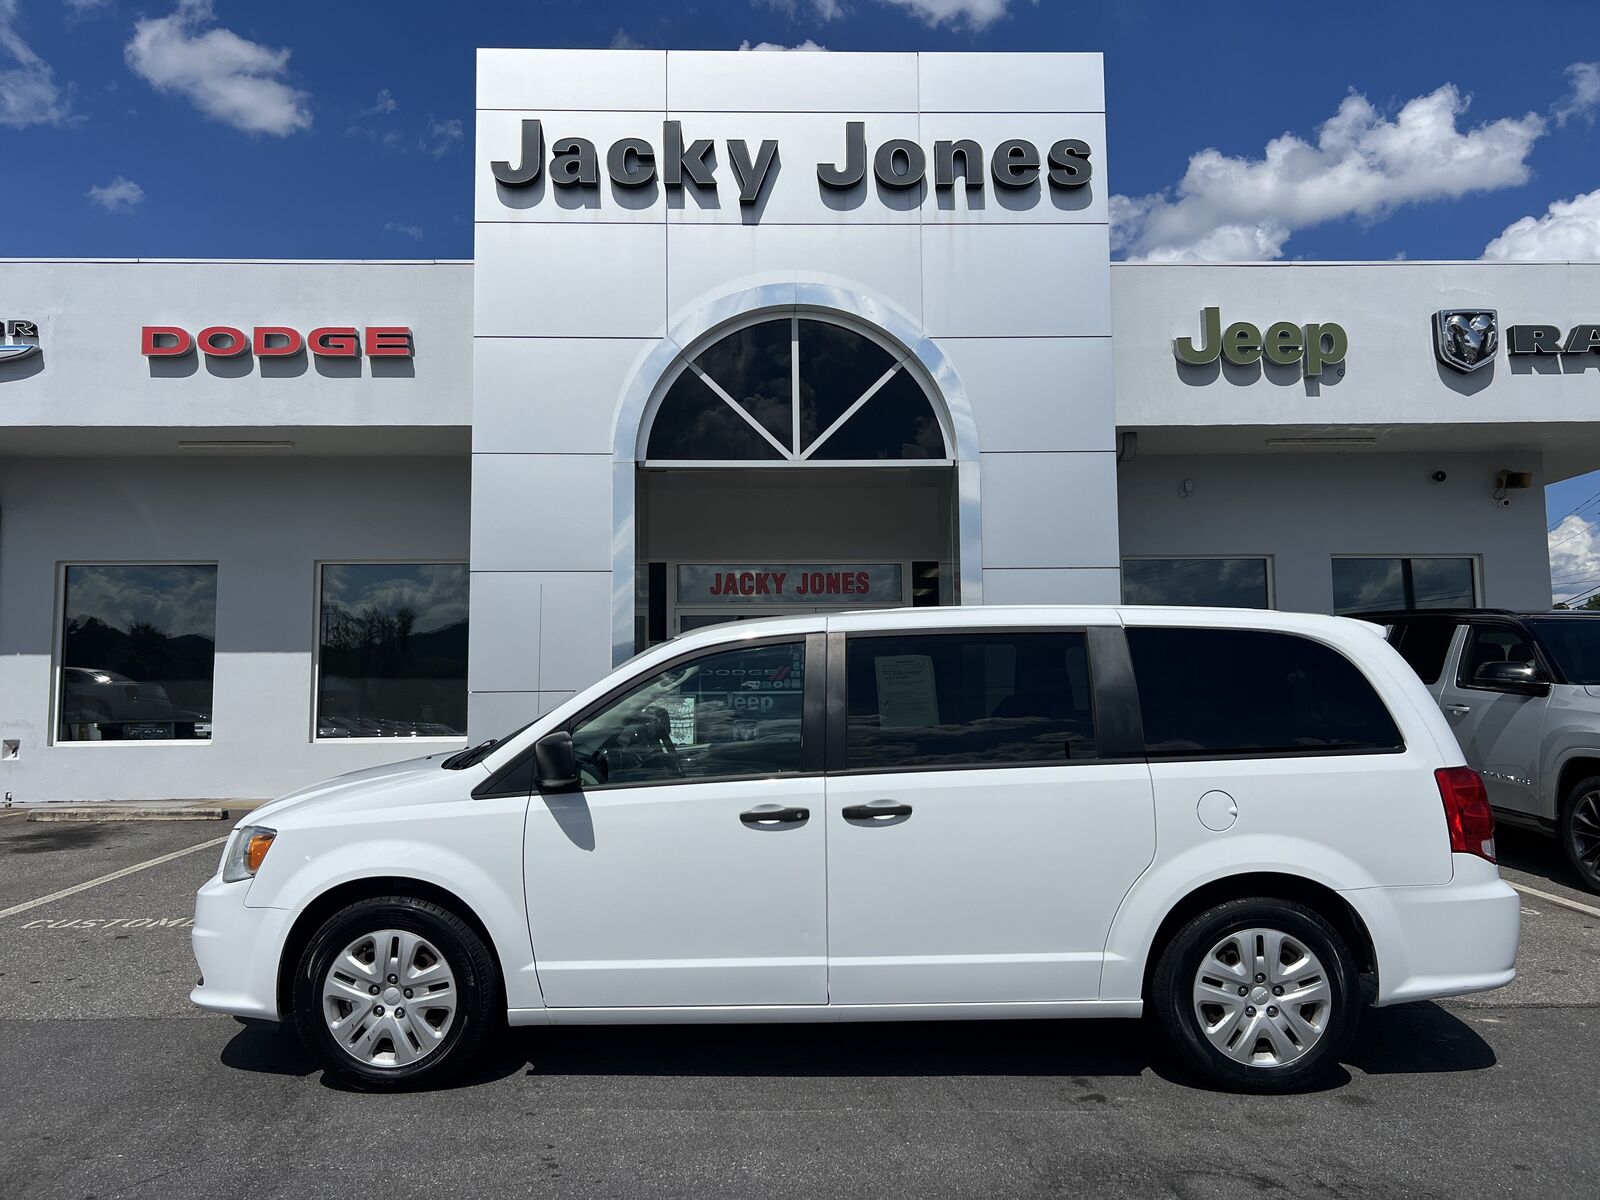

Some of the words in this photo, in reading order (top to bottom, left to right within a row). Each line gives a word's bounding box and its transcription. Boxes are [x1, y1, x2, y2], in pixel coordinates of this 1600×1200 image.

[490, 119, 780, 203] Jacky
[817, 121, 1093, 189] Jones
[141, 326, 412, 357] DODGE
[1173, 306, 1348, 377] Jeep
[709, 572, 787, 595] JACKY
[796, 572, 870, 594] JONES
